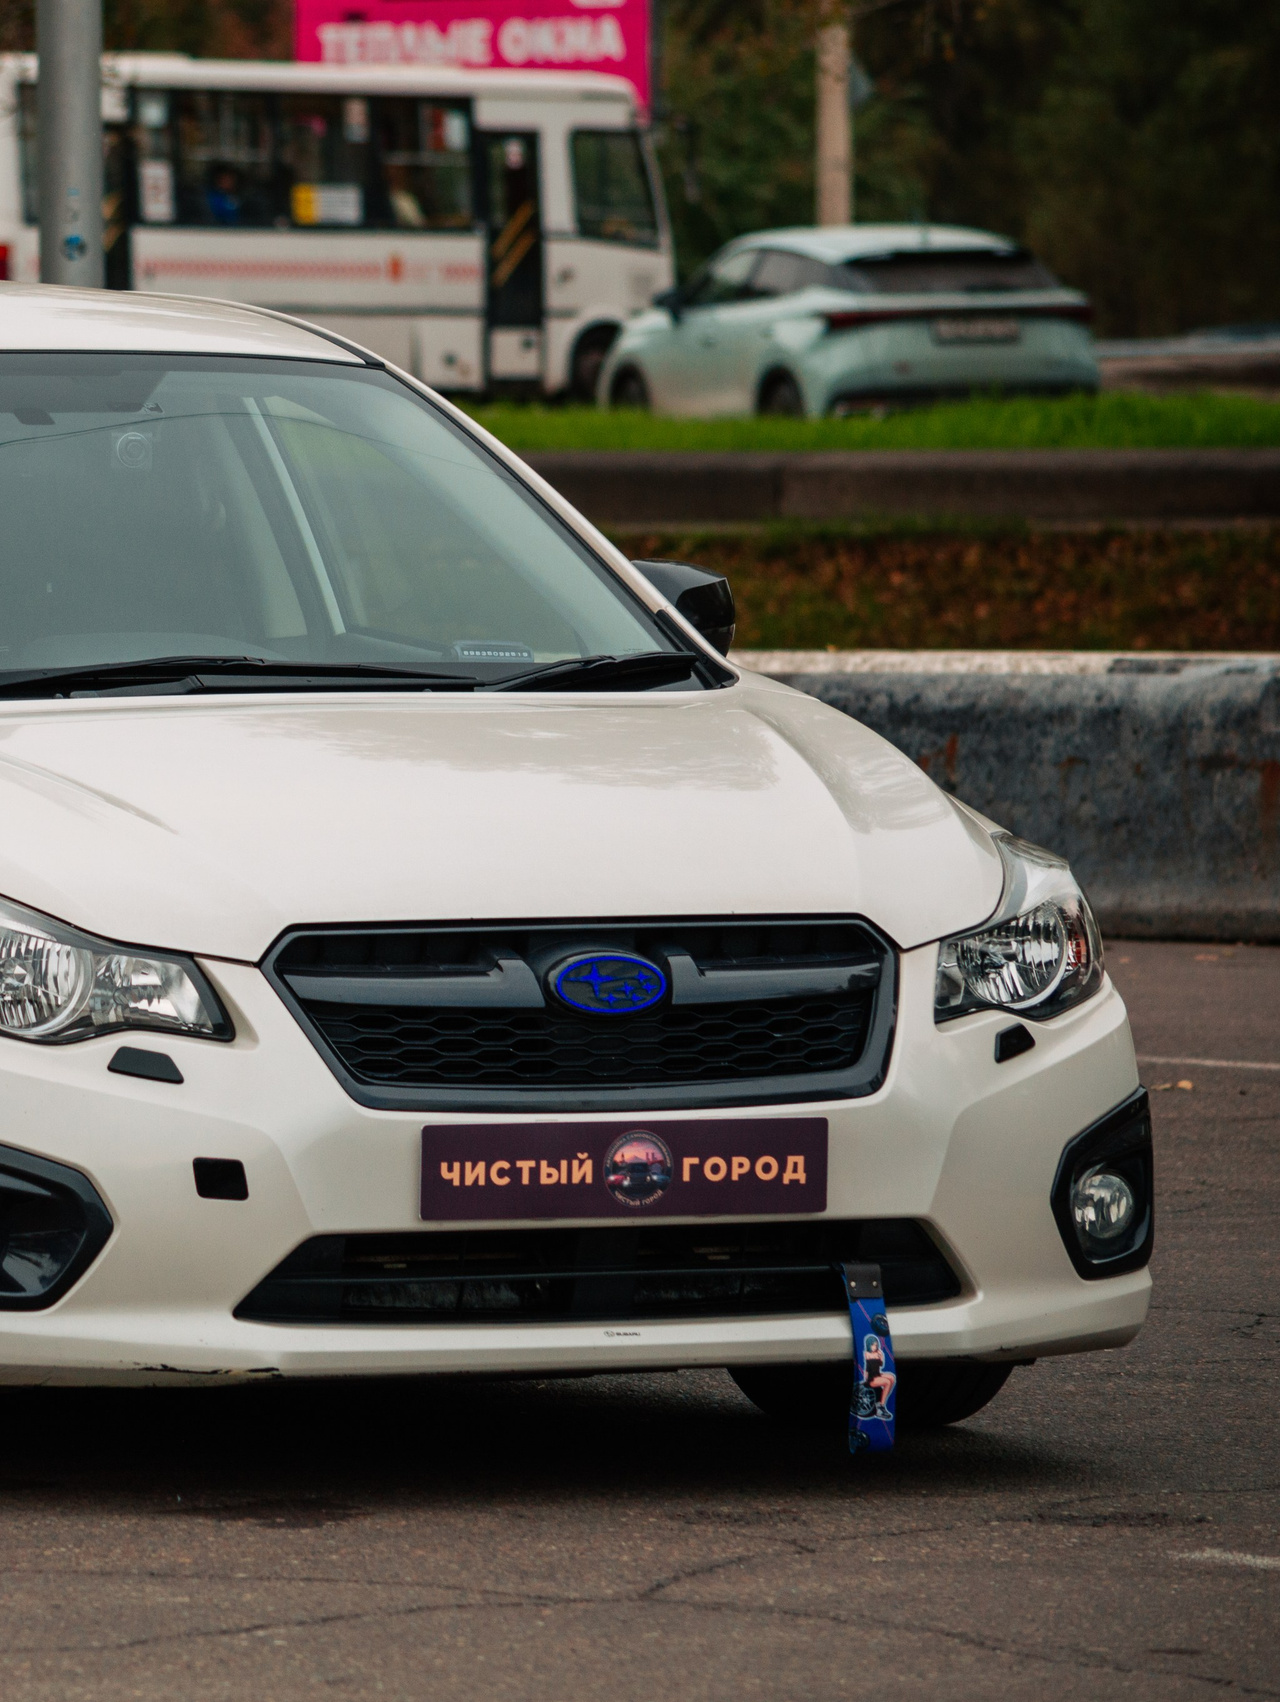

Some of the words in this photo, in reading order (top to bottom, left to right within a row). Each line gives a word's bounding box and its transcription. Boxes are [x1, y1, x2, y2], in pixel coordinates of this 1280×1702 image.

[317, 20, 494, 66] ТЕПЛЫЕ
[498, 15, 626, 65] ОКНА
[440, 1152, 593, 1187] ЧИСТЫЙ
[682, 1155, 807, 1185] ГОРОД
[642, 1188, 663, 1205] ГОРОД
